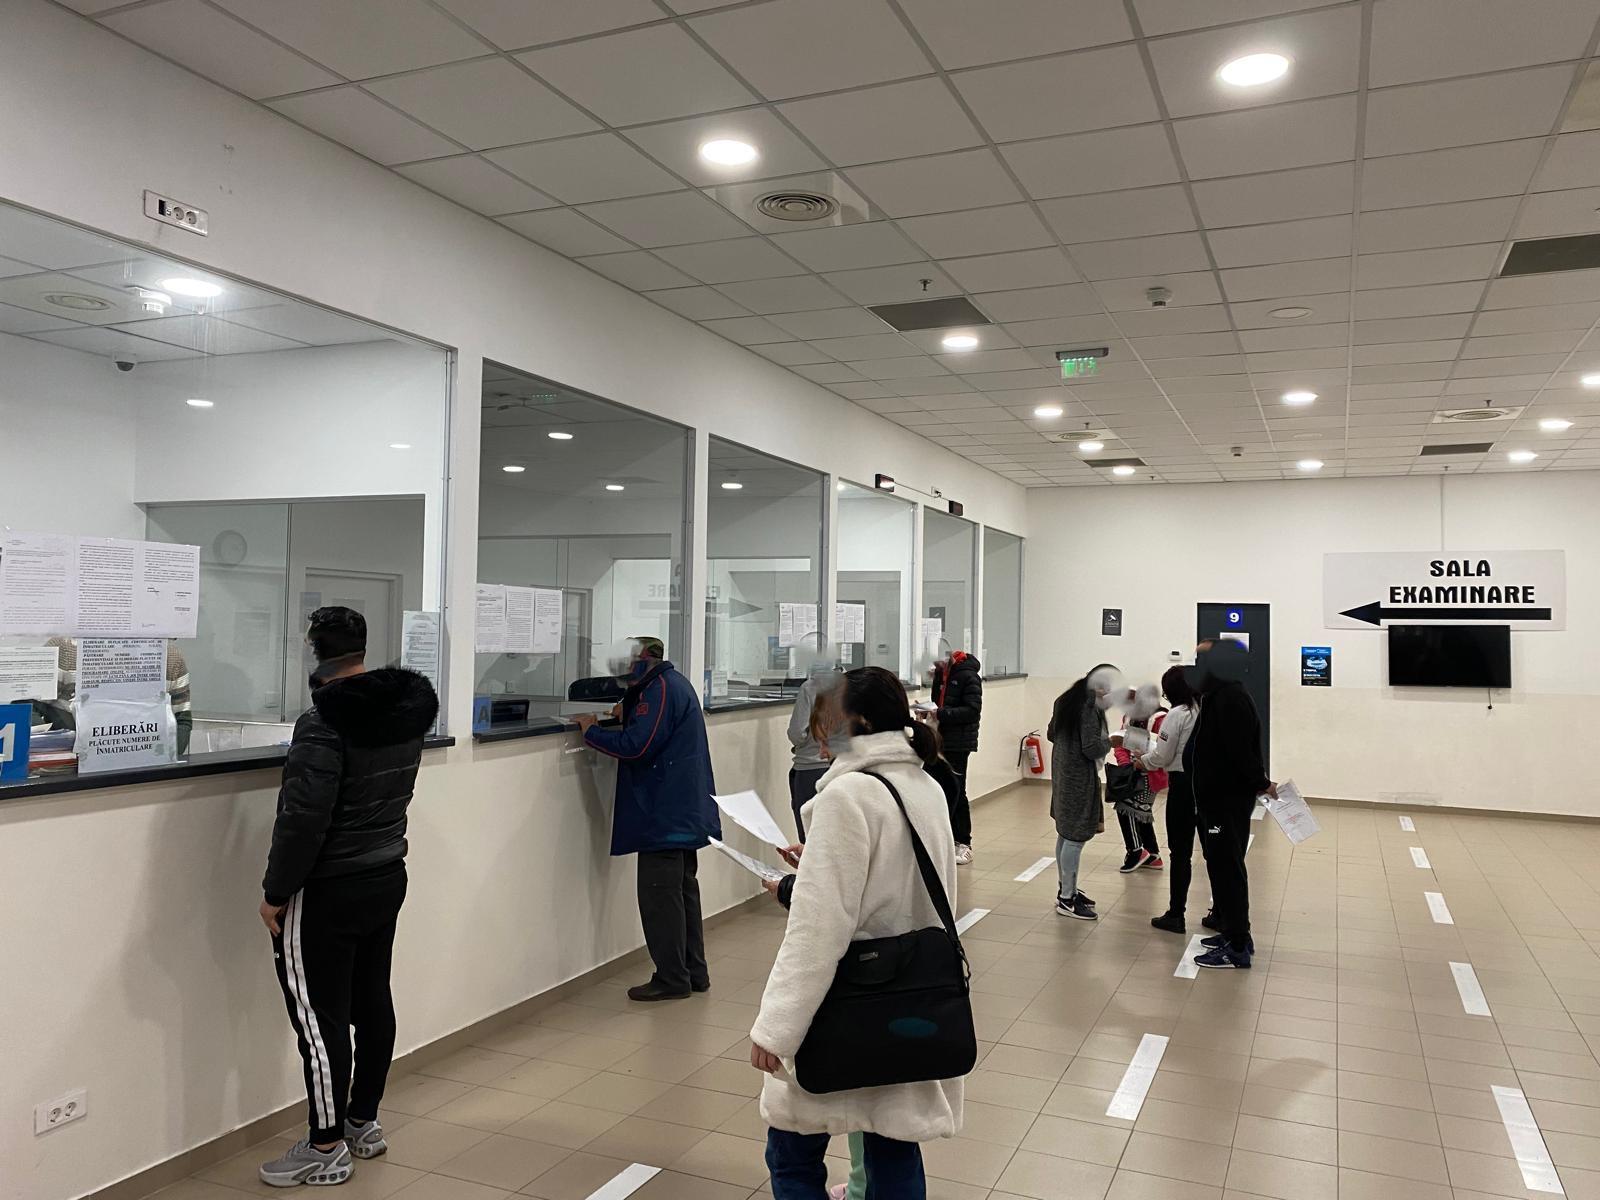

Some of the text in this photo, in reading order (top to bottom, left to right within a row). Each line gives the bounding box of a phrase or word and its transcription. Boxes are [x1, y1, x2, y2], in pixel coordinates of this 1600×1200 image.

[1430, 560, 1491, 577] SALA
[1389, 586, 1535, 604] EXAMINARE
[1229, 612, 1240, 623] 9
[92, 721, 158, 737] ELIBERĂRI
[122, 736, 150, 744] NUMERE
[96, 744, 153, 755] ÎNMATRICULARE
